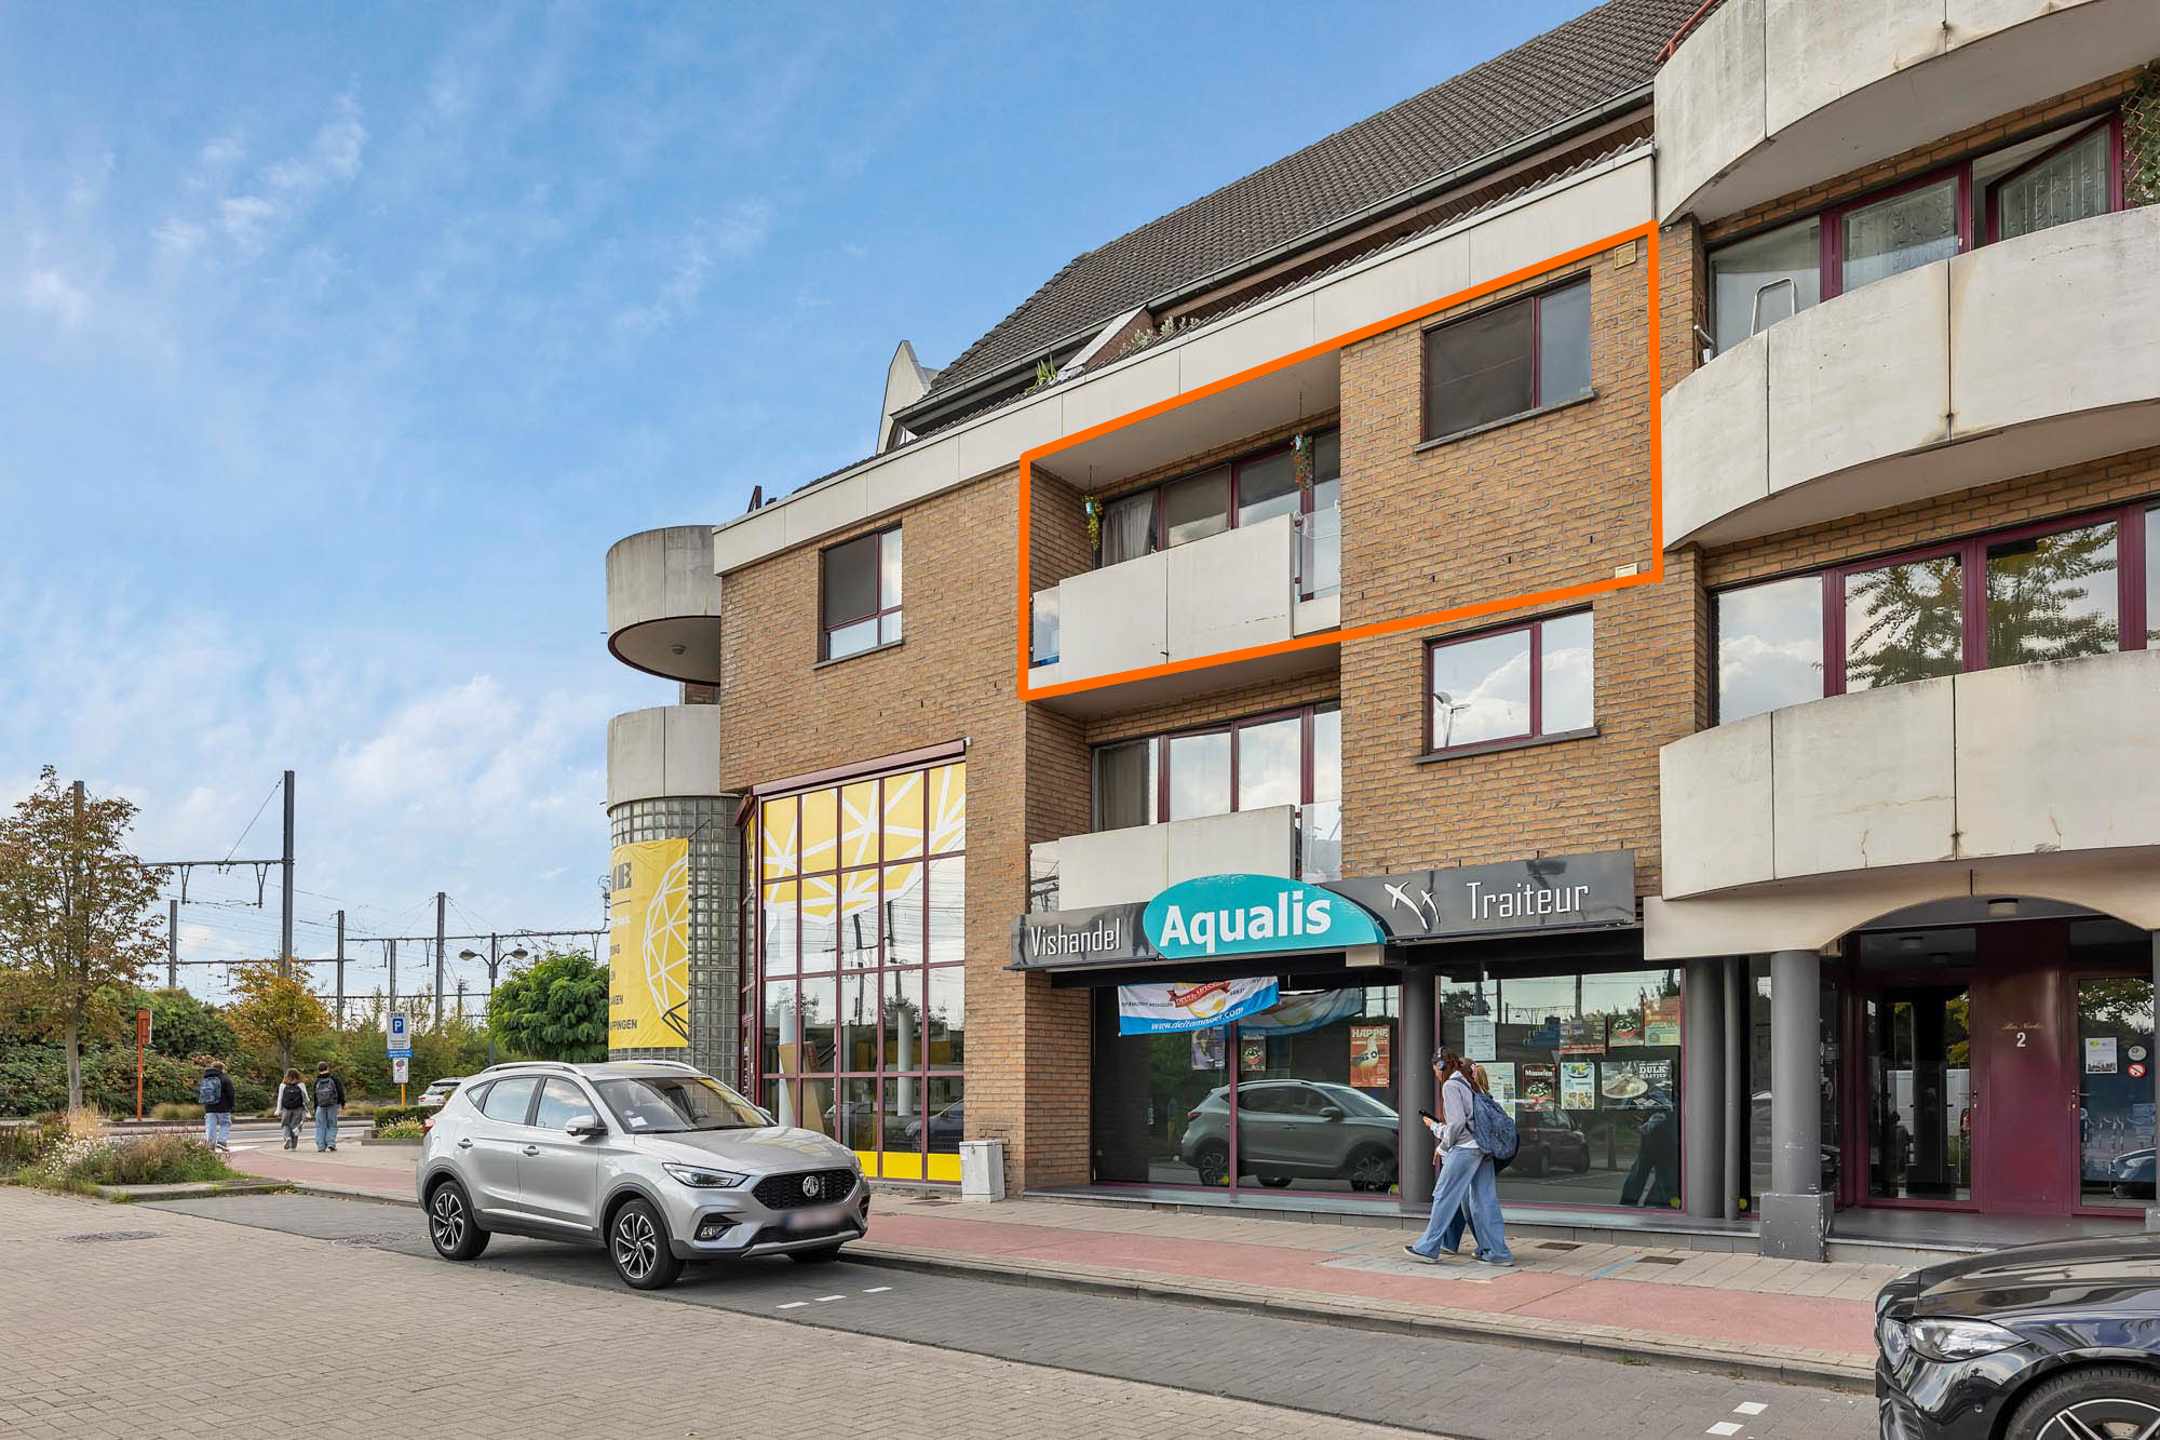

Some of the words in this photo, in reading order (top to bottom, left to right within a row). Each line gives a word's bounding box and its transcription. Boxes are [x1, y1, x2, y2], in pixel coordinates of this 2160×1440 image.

[1466, 881, 1589, 920] Traiteur
[1159, 889, 1332, 954] Aqualis
[1030, 917, 1121, 957] Vishandel
[394, 1020, 402, 1032] P
[2016, 1031, 2026, 1048] 2
[1639, 1065, 1667, 1074] DULK
